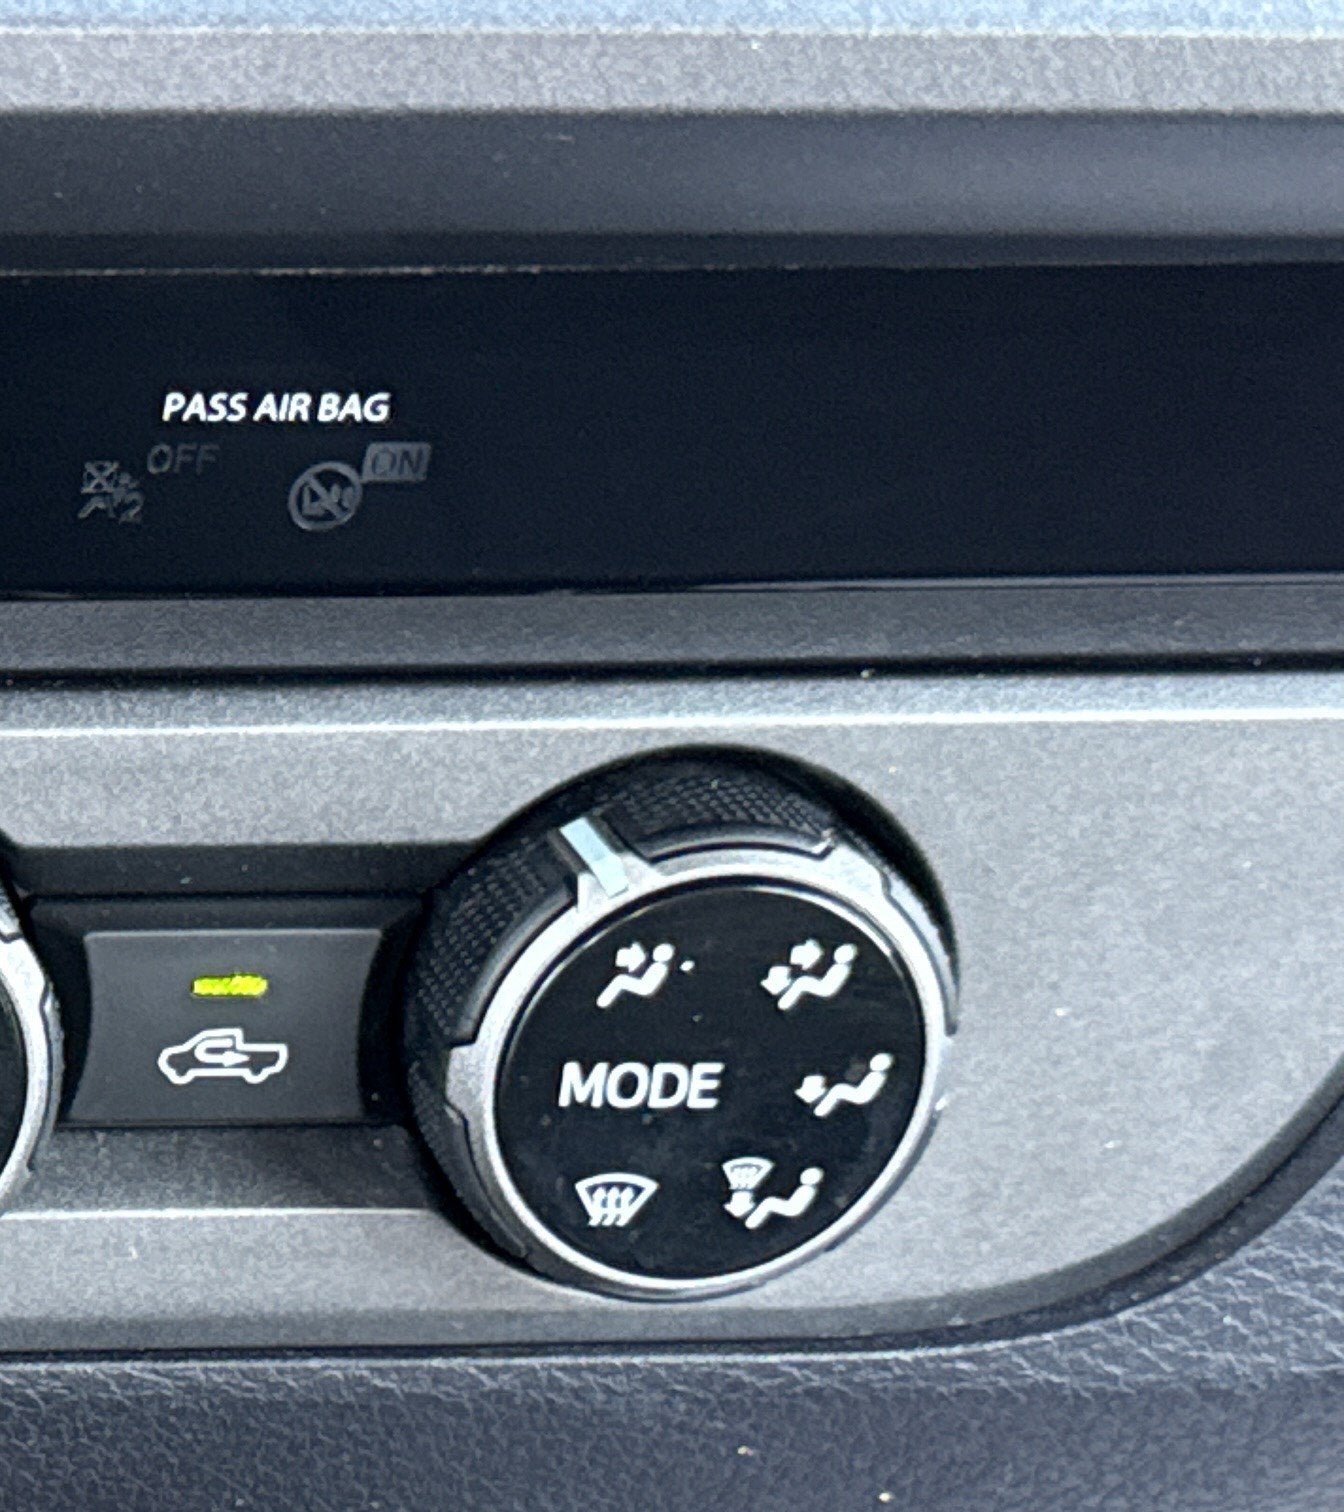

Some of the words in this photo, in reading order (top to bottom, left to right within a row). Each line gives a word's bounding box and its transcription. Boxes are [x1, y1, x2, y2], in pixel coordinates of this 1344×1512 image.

[162, 391, 248, 423] PASS
[252, 391, 313, 423] AIR
[316, 391, 392, 423] BAG
[144, 442, 221, 476] OFF
[369, 446, 422, 478] ON
[558, 1061, 725, 1109] MODE
